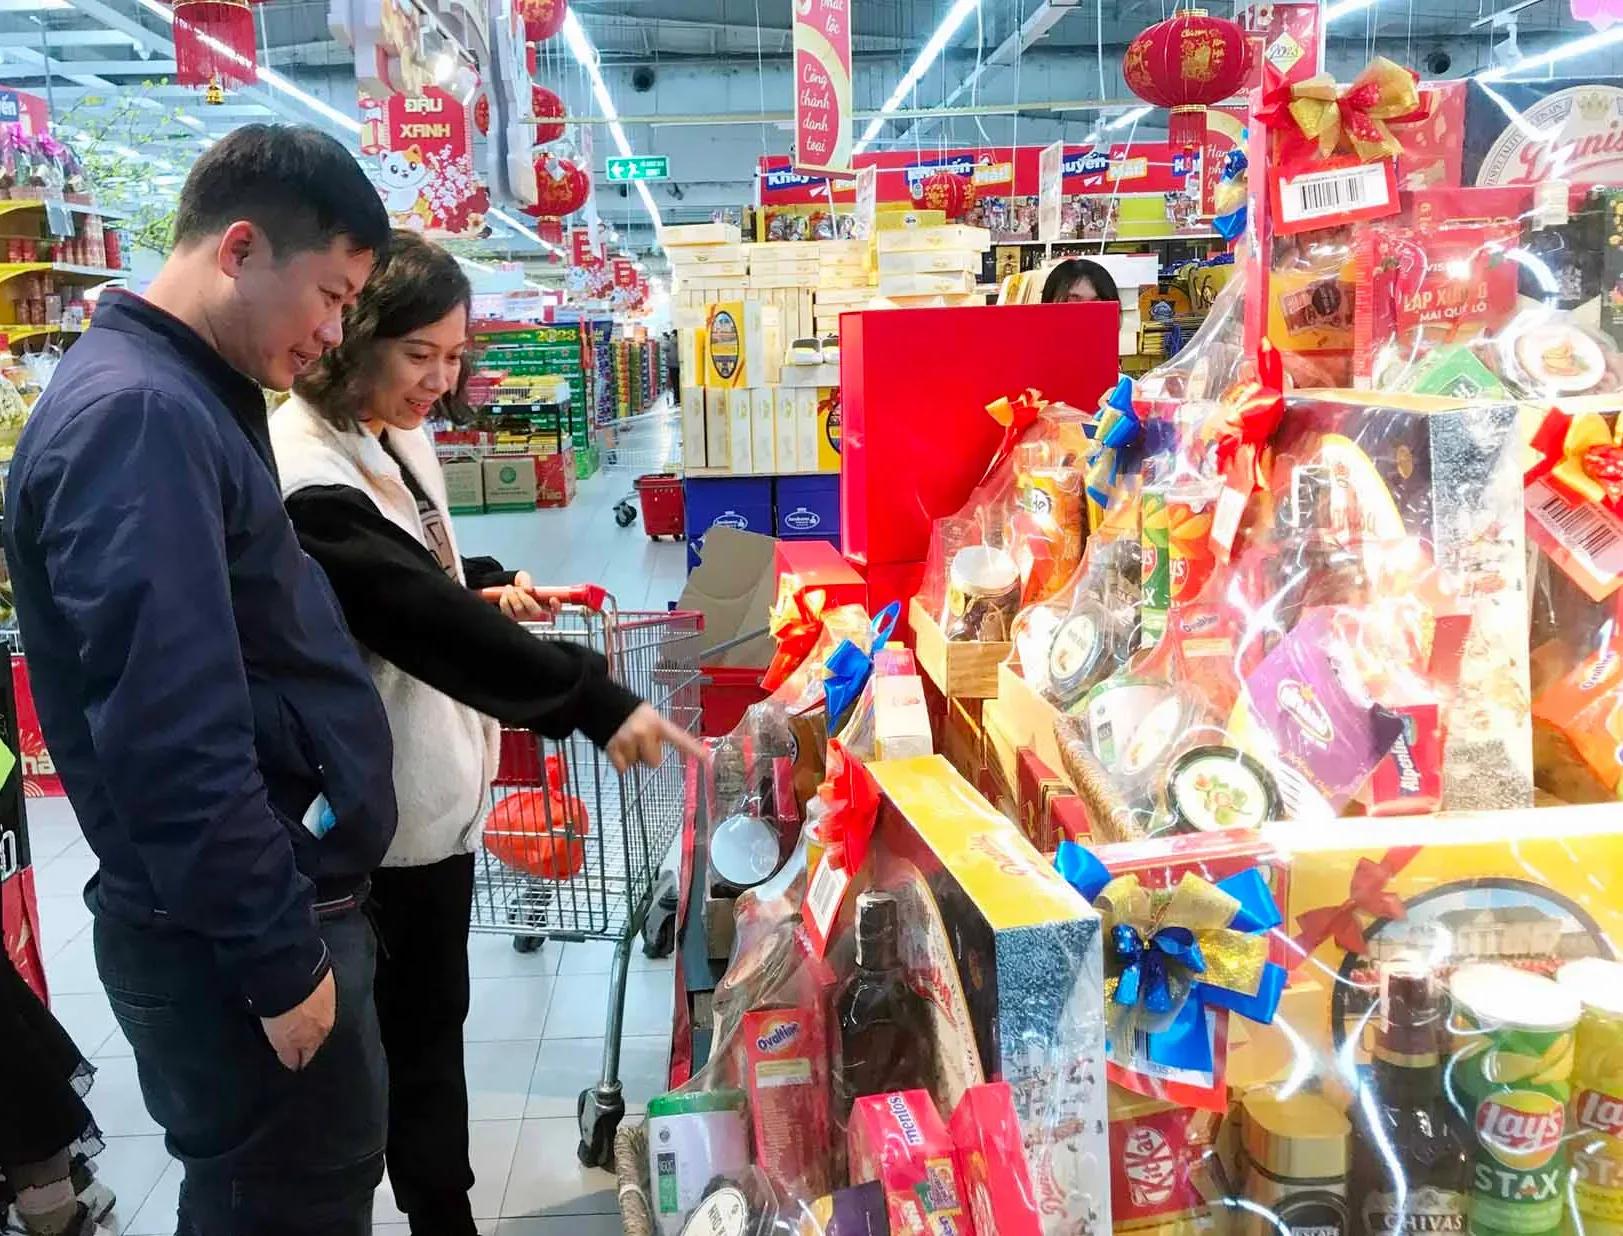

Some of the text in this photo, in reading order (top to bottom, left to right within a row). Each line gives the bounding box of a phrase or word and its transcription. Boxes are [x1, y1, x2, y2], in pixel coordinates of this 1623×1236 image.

[803, 111, 829, 131] danh
[757, 1022, 800, 1052] Ovaltine
[889, 1095, 923, 1145] mentos
[1474, 1163, 1559, 1201] STAX
[1384, 1213, 1464, 1232] CHIVAS
